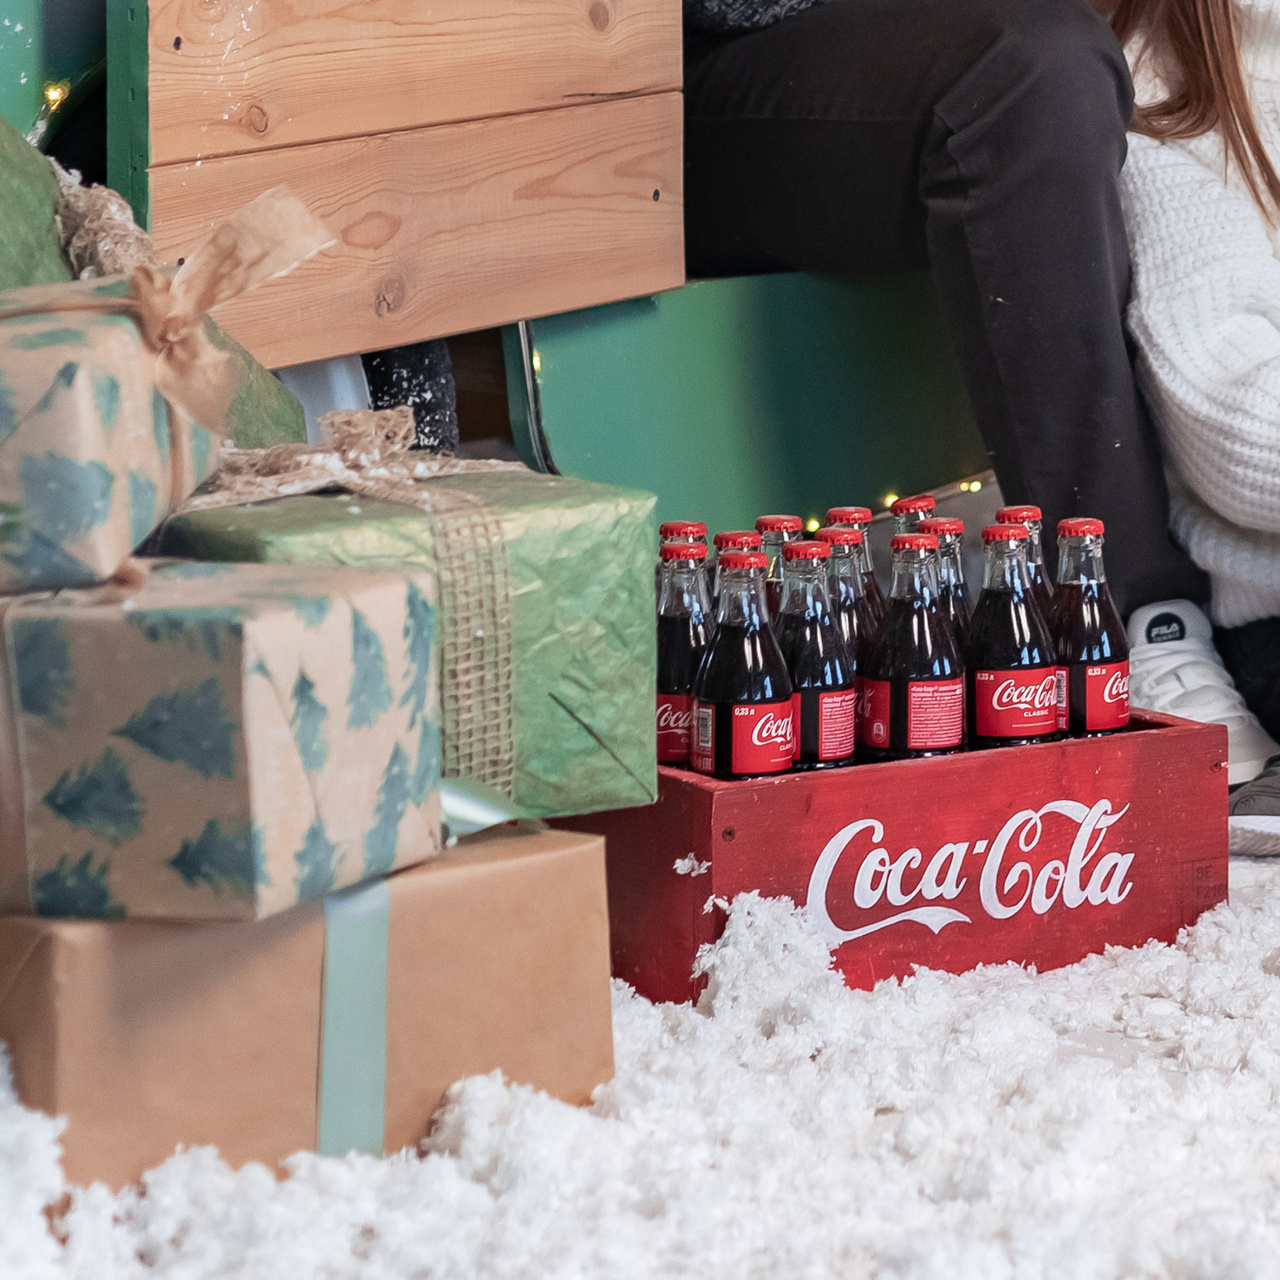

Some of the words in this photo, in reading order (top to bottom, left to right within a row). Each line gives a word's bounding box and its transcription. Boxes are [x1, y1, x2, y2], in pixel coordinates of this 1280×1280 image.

[1151, 622, 1180, 638] FILA
[1023, 709, 1049, 718] CLASSIC
[806, 798, 1136, 942] Coca-Cola
